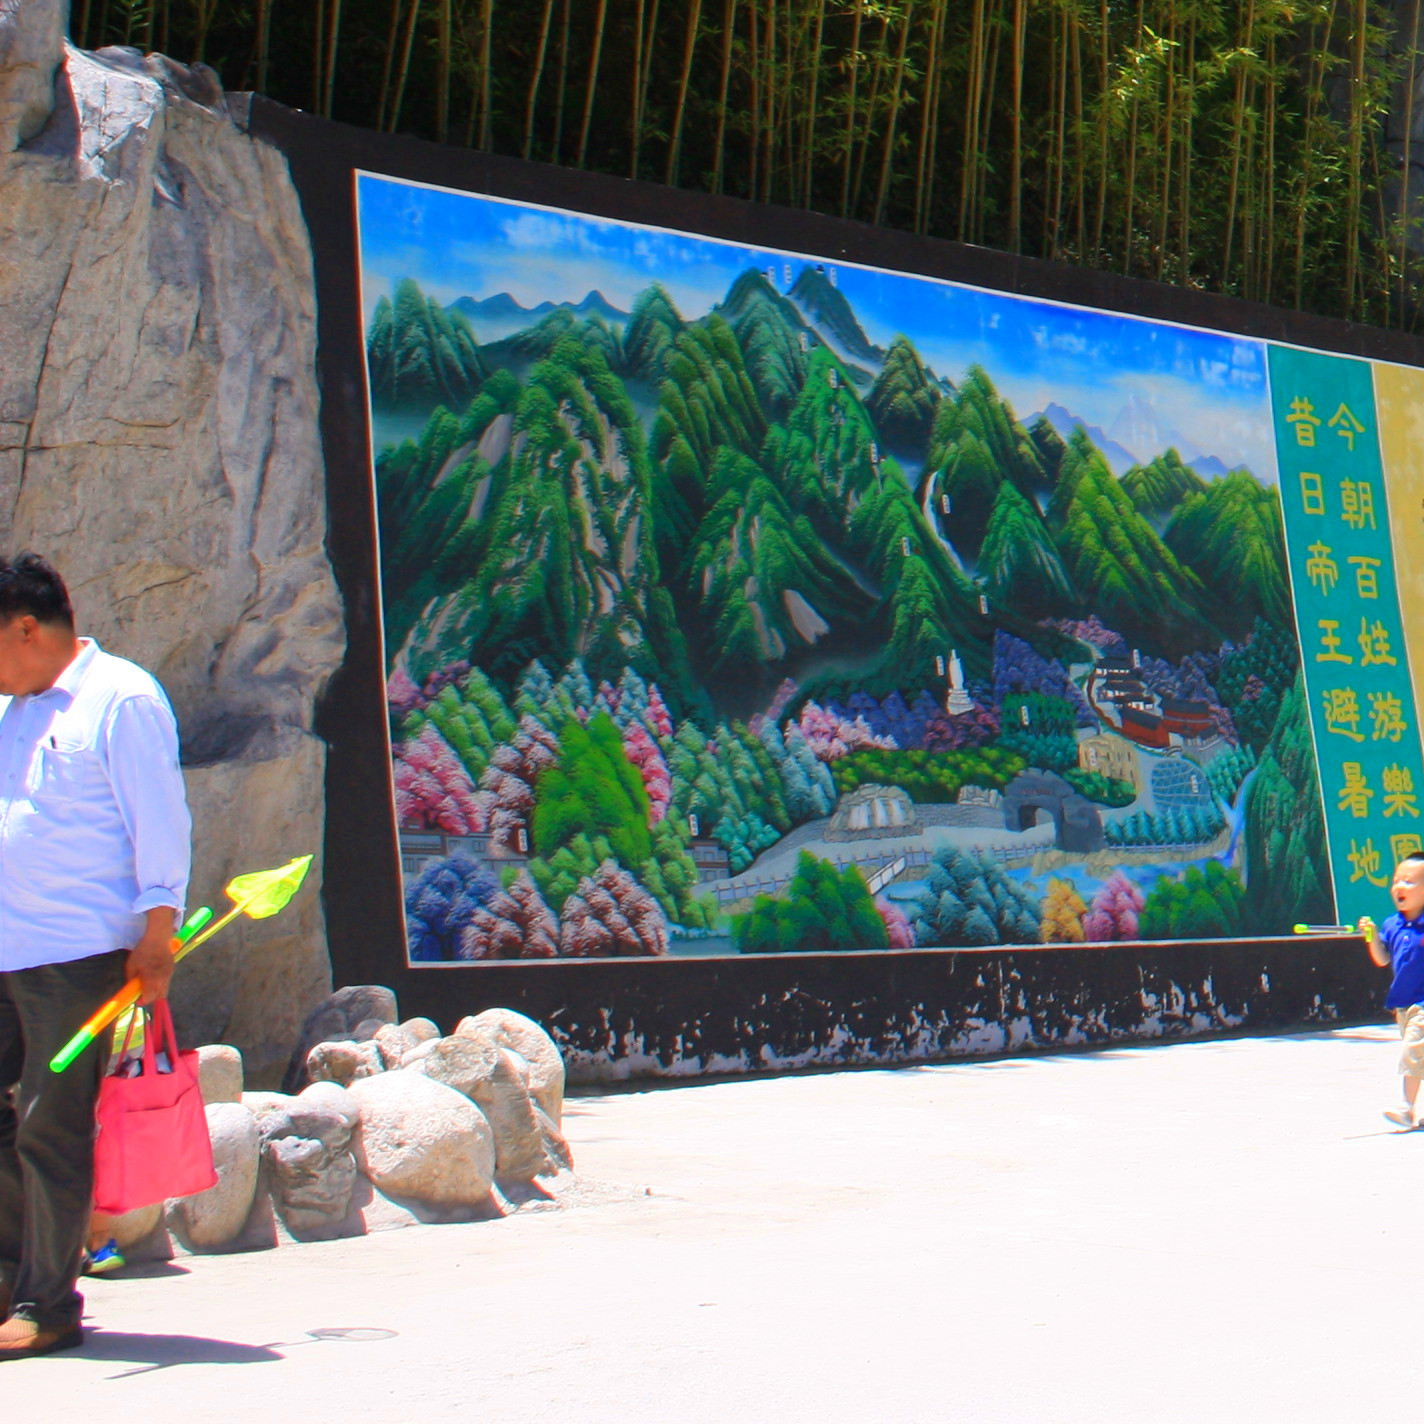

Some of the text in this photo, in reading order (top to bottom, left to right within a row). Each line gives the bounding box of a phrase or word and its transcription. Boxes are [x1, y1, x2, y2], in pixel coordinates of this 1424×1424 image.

[1286, 395, 1388, 888] 昔日帝王避暑地
